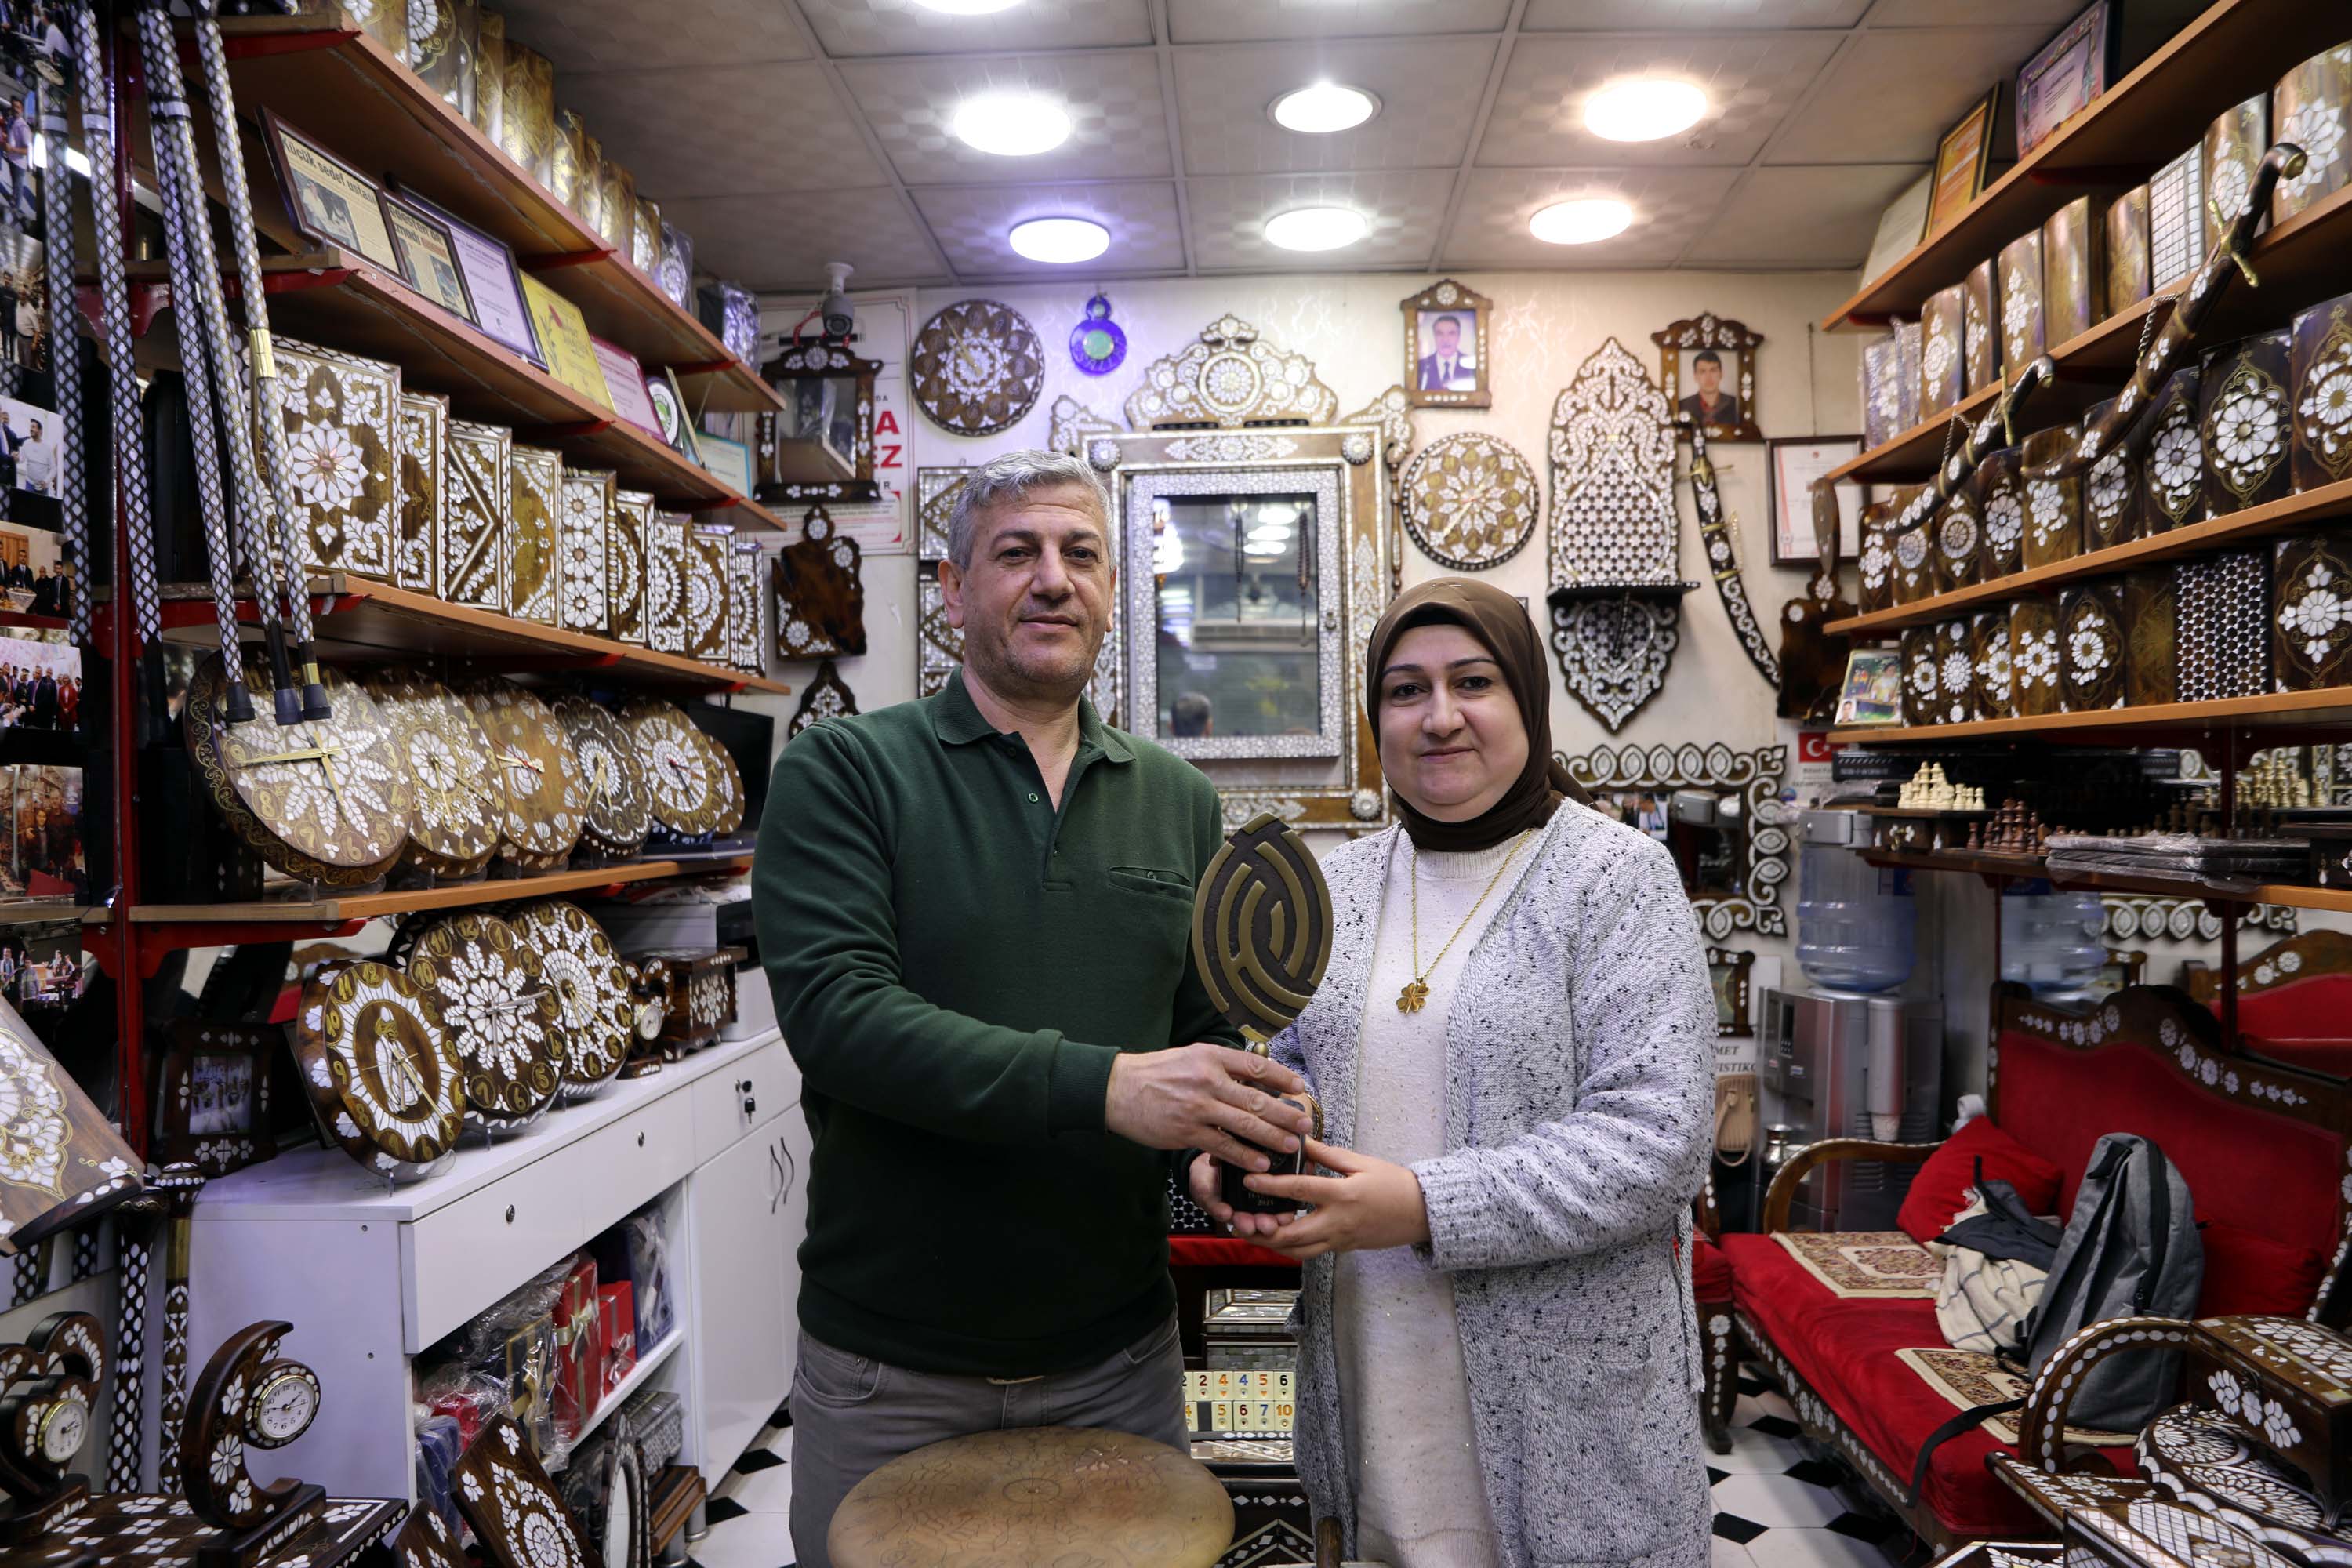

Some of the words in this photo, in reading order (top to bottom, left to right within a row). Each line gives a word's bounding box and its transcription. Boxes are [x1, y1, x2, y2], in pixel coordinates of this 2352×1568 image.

[874, 410, 900, 435] A
[1199, 1374, 1207, 1387] 2
[1218, 1374, 1229, 1386] 4
[1239, 1374, 1249, 1386] 4
[1259, 1374, 1268, 1386] 5
[1279, 1374, 1288, 1386] 6
[1218, 1404, 1226, 1417] 5
[1239, 1404, 1248, 1416] 6
[1260, 1404, 1269, 1417] 7
[1276, 1404, 1293, 1417] 10
